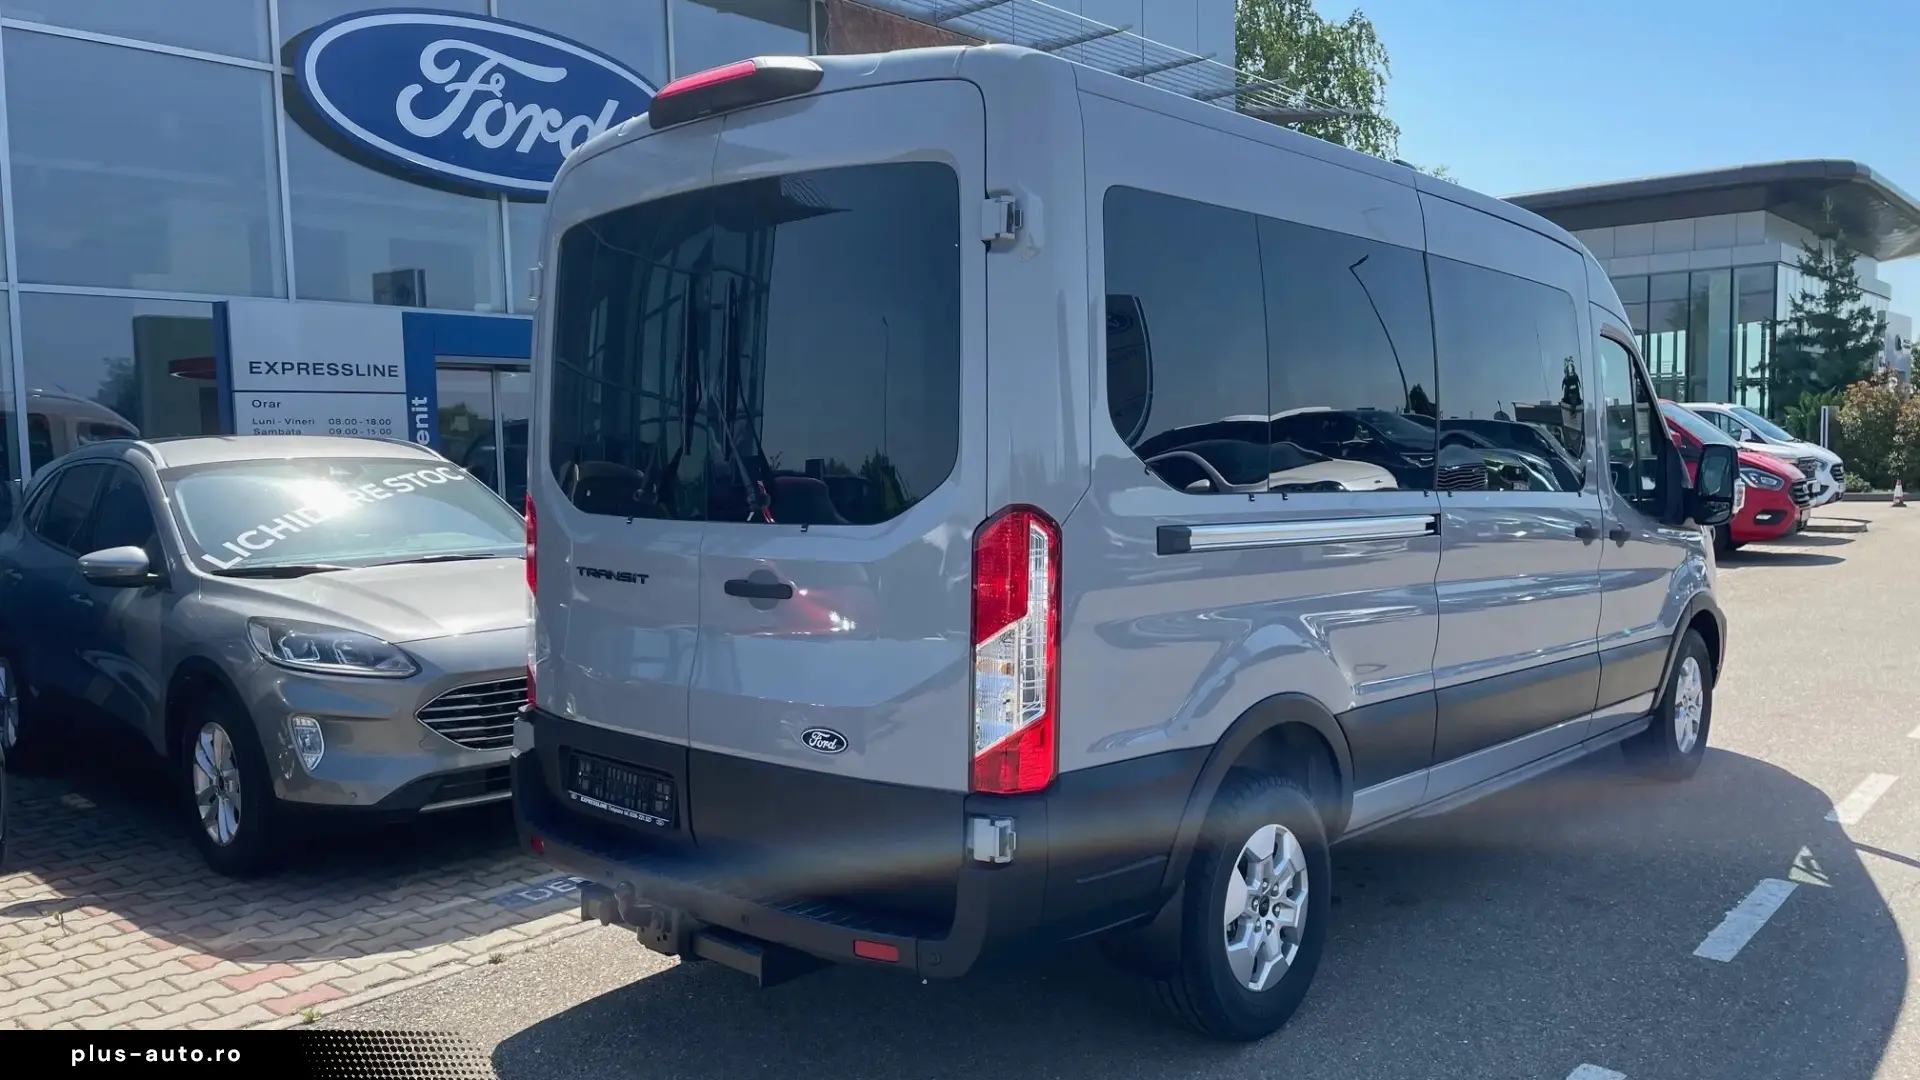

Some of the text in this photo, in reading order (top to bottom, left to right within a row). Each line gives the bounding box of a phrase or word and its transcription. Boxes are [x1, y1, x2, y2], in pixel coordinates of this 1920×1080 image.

[396, 39, 619, 159] Ford
[248, 361, 399, 378] EXPRESSLINE
[252, 399, 282, 409] Orar
[252, 418, 275, 426] Luni
[284, 418, 316, 426] Vineri
[382, 466, 465, 494] STOC
[576, 565, 650, 585] TRANSIT
[808, 731, 838, 750] Ford
